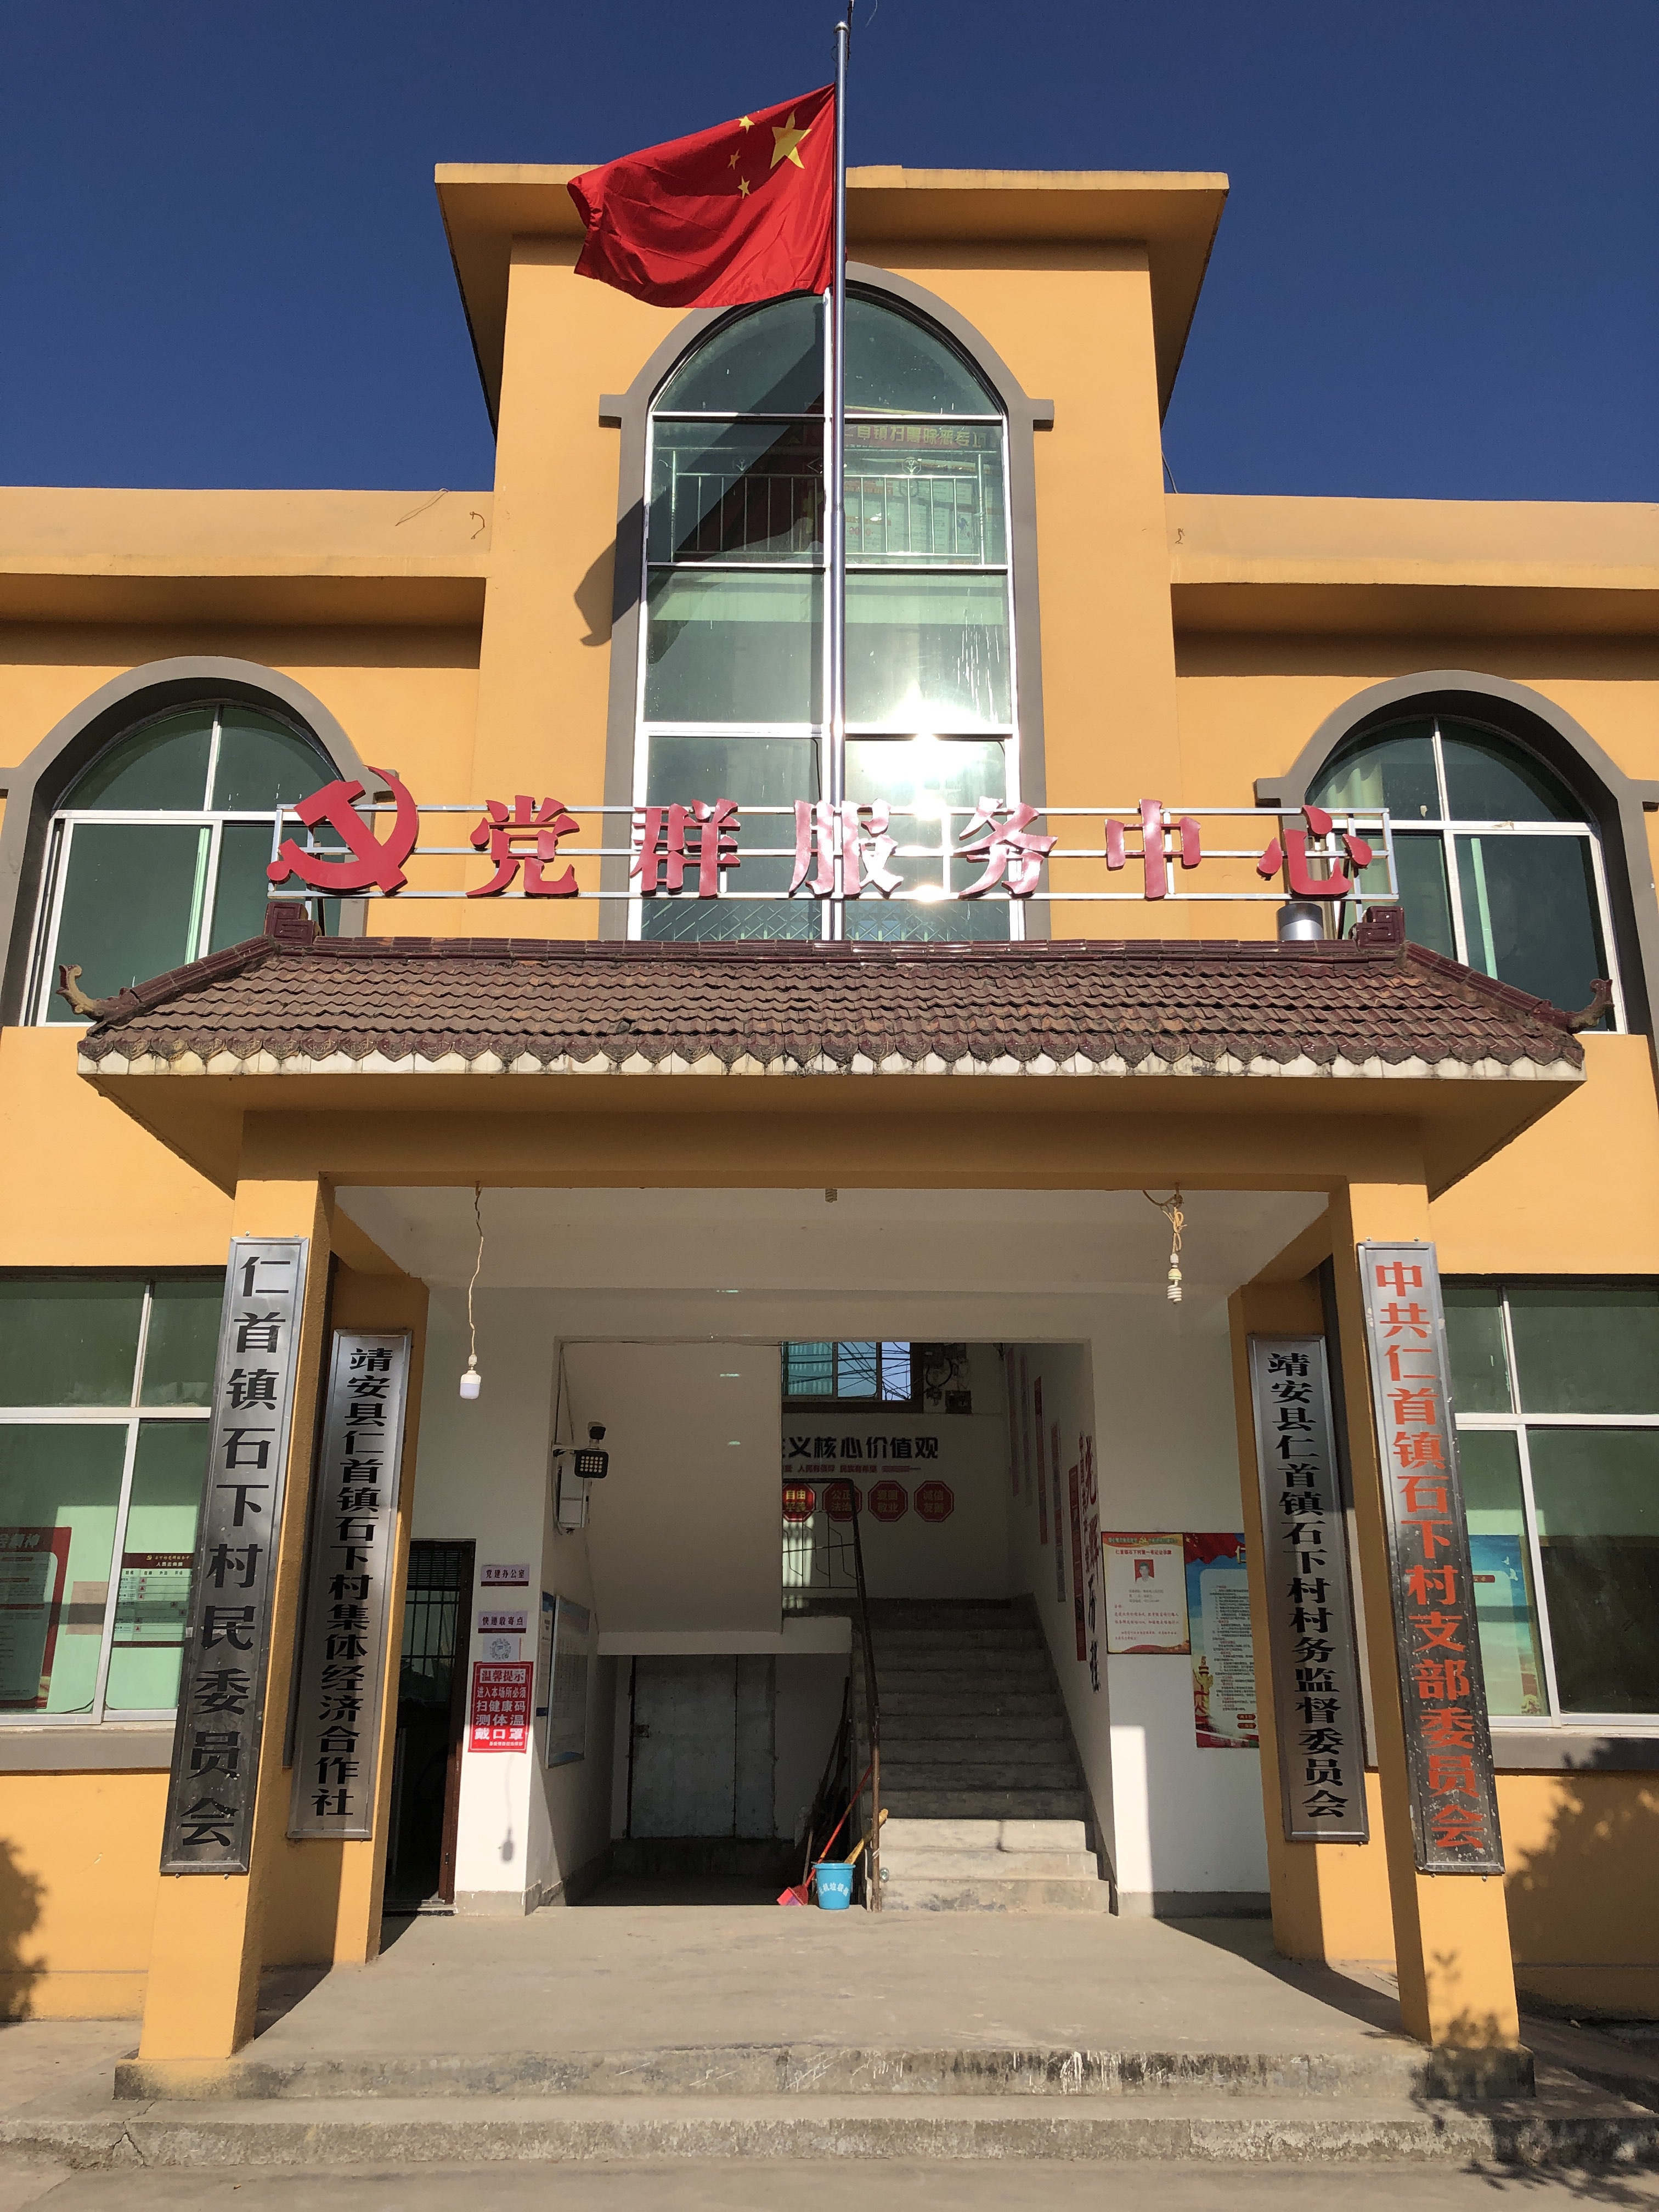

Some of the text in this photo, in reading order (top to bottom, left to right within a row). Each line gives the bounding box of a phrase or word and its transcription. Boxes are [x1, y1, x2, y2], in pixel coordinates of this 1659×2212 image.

[466, 795, 1373, 900] 党群服务中心
[782, 1436, 939, 1459] 义核心价值观
[786, 1489, 806, 1500] 自由
[180, 1256, 291, 1847] 仁首镇石下村民委员会
[1375, 1261, 1485, 1849] 中共仁首镇石下村支部委员会
[486, 1569, 525, 1578] 党建办公室
[311, 1347, 393, 1817] 靖安县仁首镇石下村集体经济合作社
[1267, 1352, 1350, 1818] 靖安县仁首镇石下村村务监督委员会
[482, 1616, 523, 1626] 快递收寄点
[482, 1670, 524, 1681] 温馨提示
[477, 1686, 527, 1699] 进入本场所必须
[476, 1700, 526, 1713] 扫健康码
[475, 1714, 524, 1726] 测体温
[474, 1728, 523, 1740] 戴口罩
